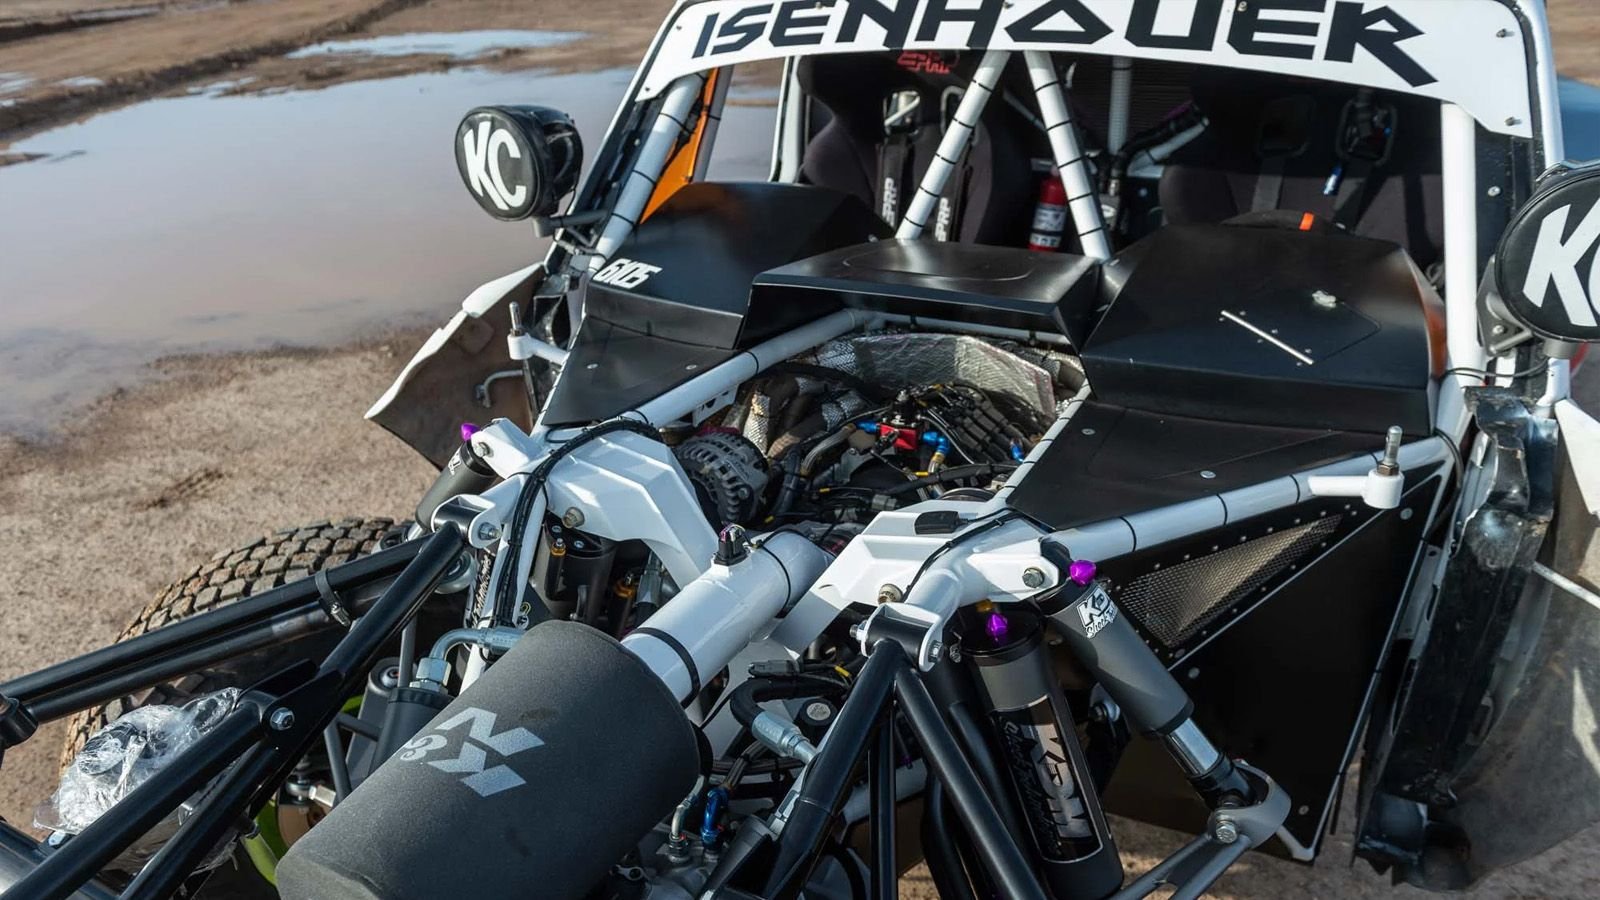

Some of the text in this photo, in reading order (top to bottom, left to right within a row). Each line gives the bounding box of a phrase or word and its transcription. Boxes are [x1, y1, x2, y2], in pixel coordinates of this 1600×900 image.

[463, 121, 527, 211] KC
[1523, 197, 1600, 327] K
[1020, 723, 1093, 838] KDM
